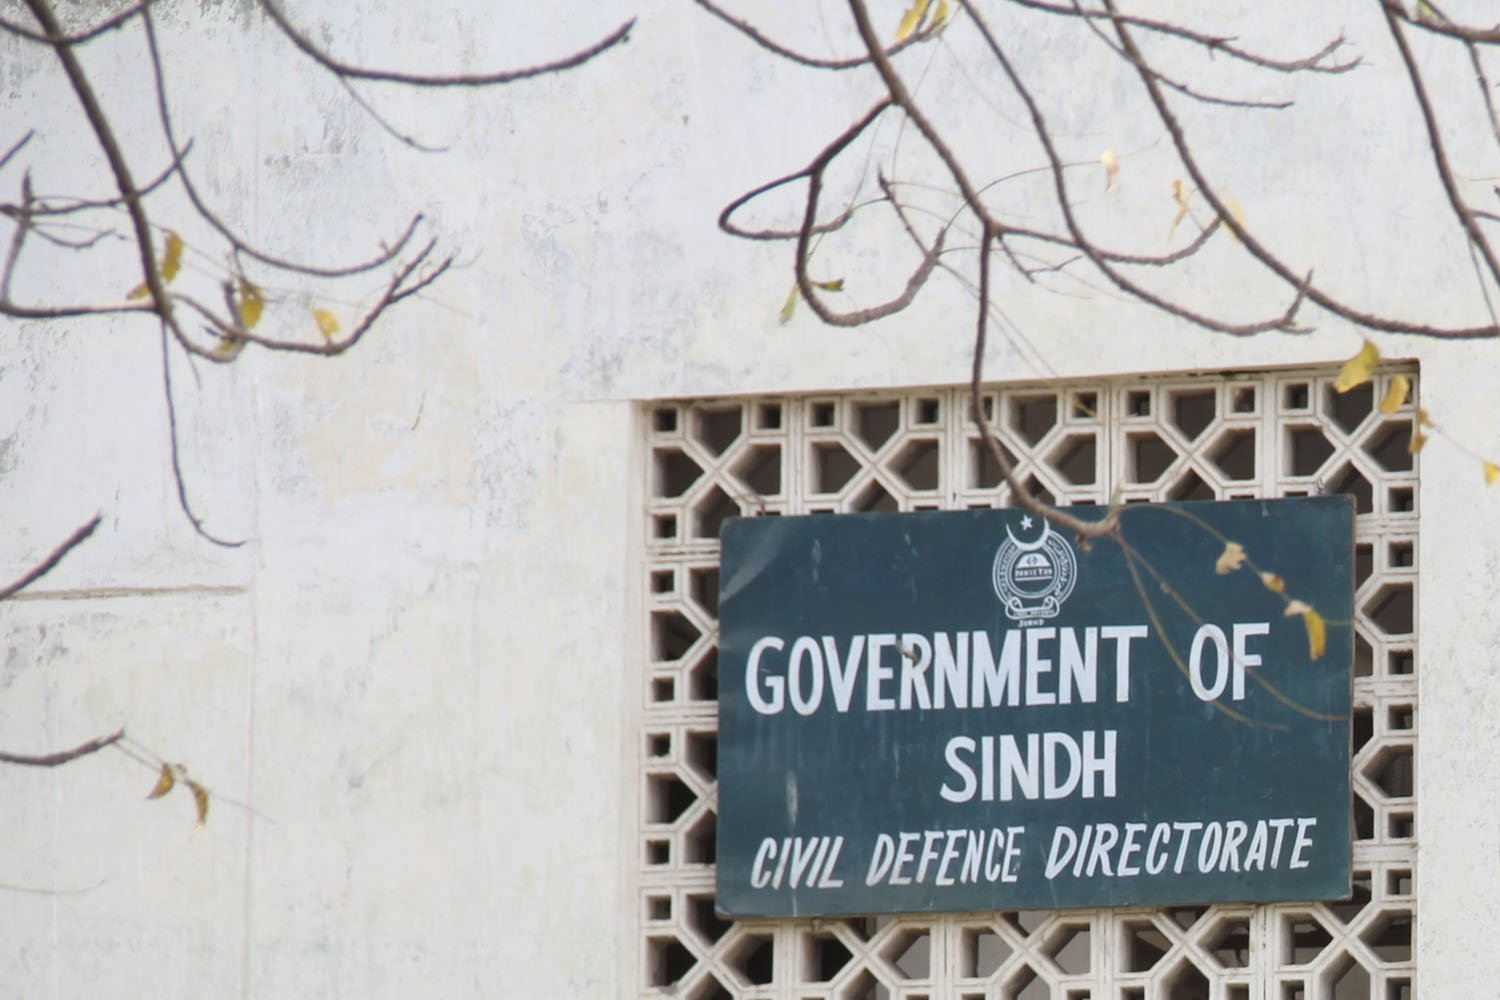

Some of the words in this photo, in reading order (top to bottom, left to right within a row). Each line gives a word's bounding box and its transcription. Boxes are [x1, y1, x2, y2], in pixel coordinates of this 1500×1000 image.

[745, 625, 1148, 716] GOVERNMENT
[1189, 622, 1270, 702] OF
[940, 730, 1117, 803] SINDH
[750, 836, 845, 890] CIVIL
[865, 826, 1025, 887] DEFENCE
[1044, 817, 1317, 881] DIRECTORATE
